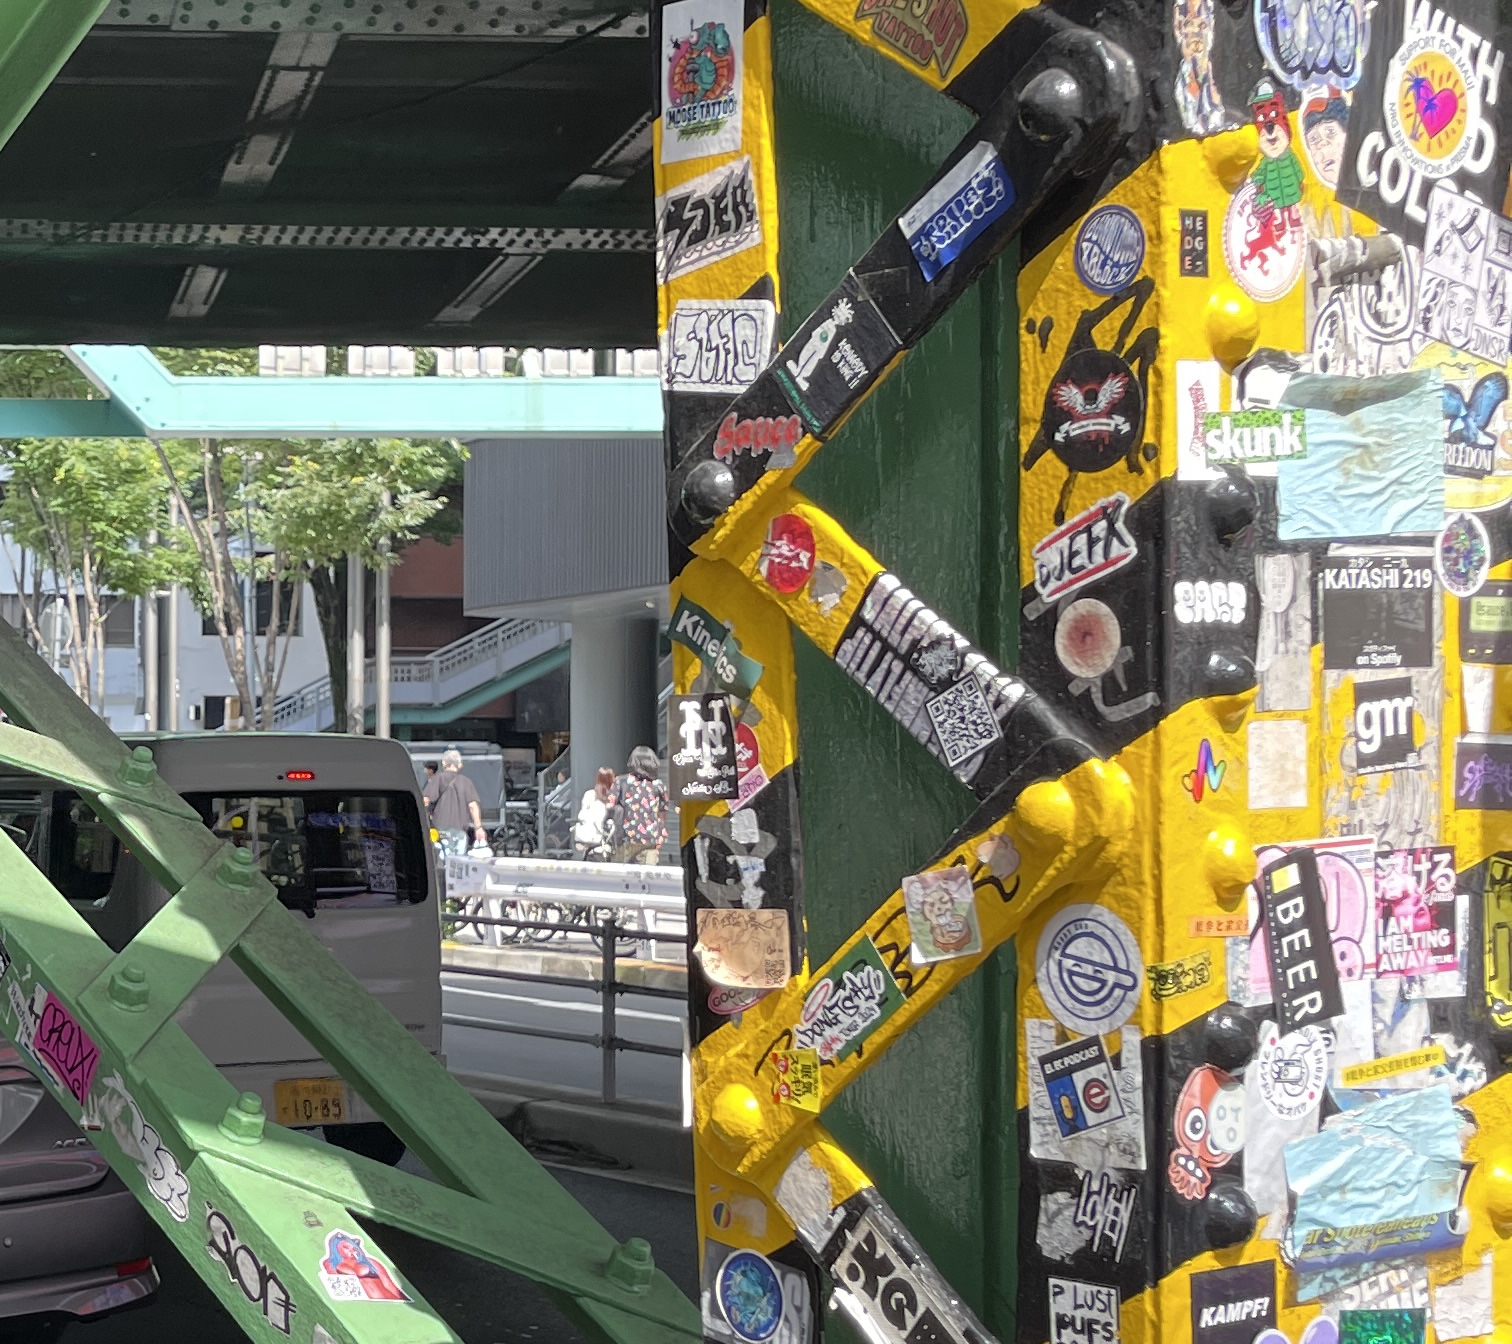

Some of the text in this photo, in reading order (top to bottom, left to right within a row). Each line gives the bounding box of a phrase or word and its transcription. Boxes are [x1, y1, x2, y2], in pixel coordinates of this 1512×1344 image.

[878, 10, 933, 61] TATTOO
[1399, 36, 1476, 92] SUPPORT FOR MAUI
[668, 101, 737, 126] MOOSE TATTOO
[1206, 414, 1304, 462] skunk
[1443, 446, 1494, 471] REEDOM
[1324, 568, 1433, 590] KATASHI 219
[675, 610, 737, 685] Kineics
[1369, 652, 1403, 667] Spotify
[1387, 916, 1414, 935] AM
[1379, 929, 1451, 955] MELTING
[1276, 895, 1323, 1021] BEER
[1378, 951, 1427, 972] AWAY
[1044, 1044, 1100, 1076] ELECPODCAST
[1200, 1297, 1270, 1330] KAMPF!
